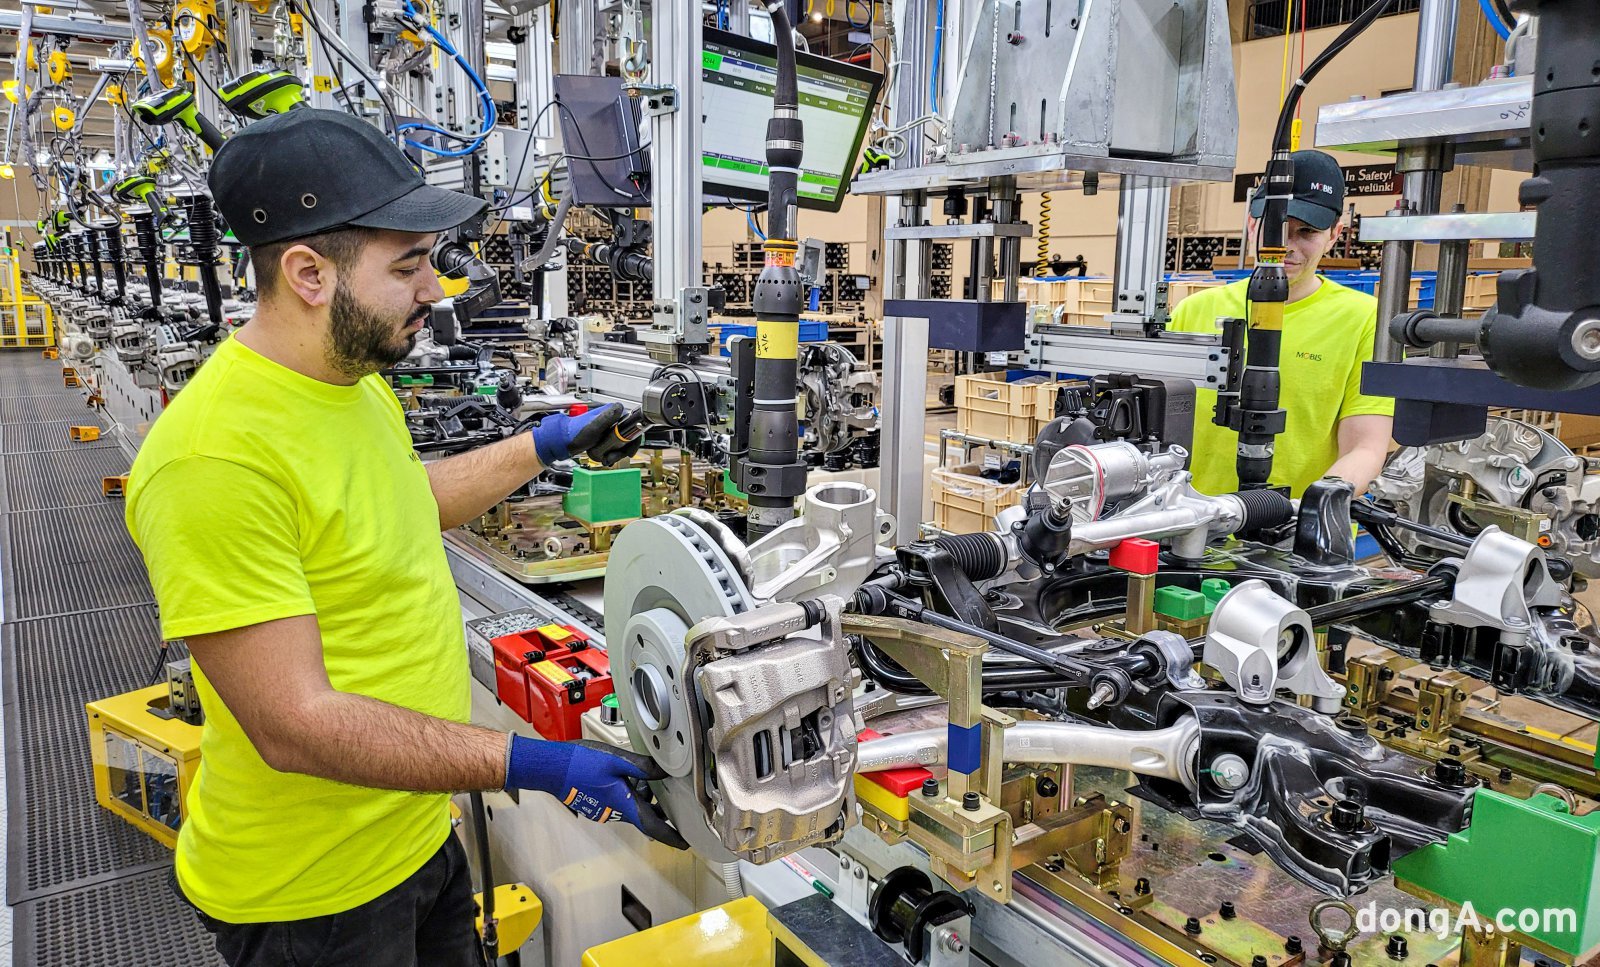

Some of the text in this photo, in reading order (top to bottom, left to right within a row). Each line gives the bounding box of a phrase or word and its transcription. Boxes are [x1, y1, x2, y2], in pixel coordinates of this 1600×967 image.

[1358, 168, 1392, 182] Safety!
[1310, 182, 1333, 194] MOBIS
[1358, 181, 1394, 193] velünk!
[1295, 351, 1322, 361] MOBIS
